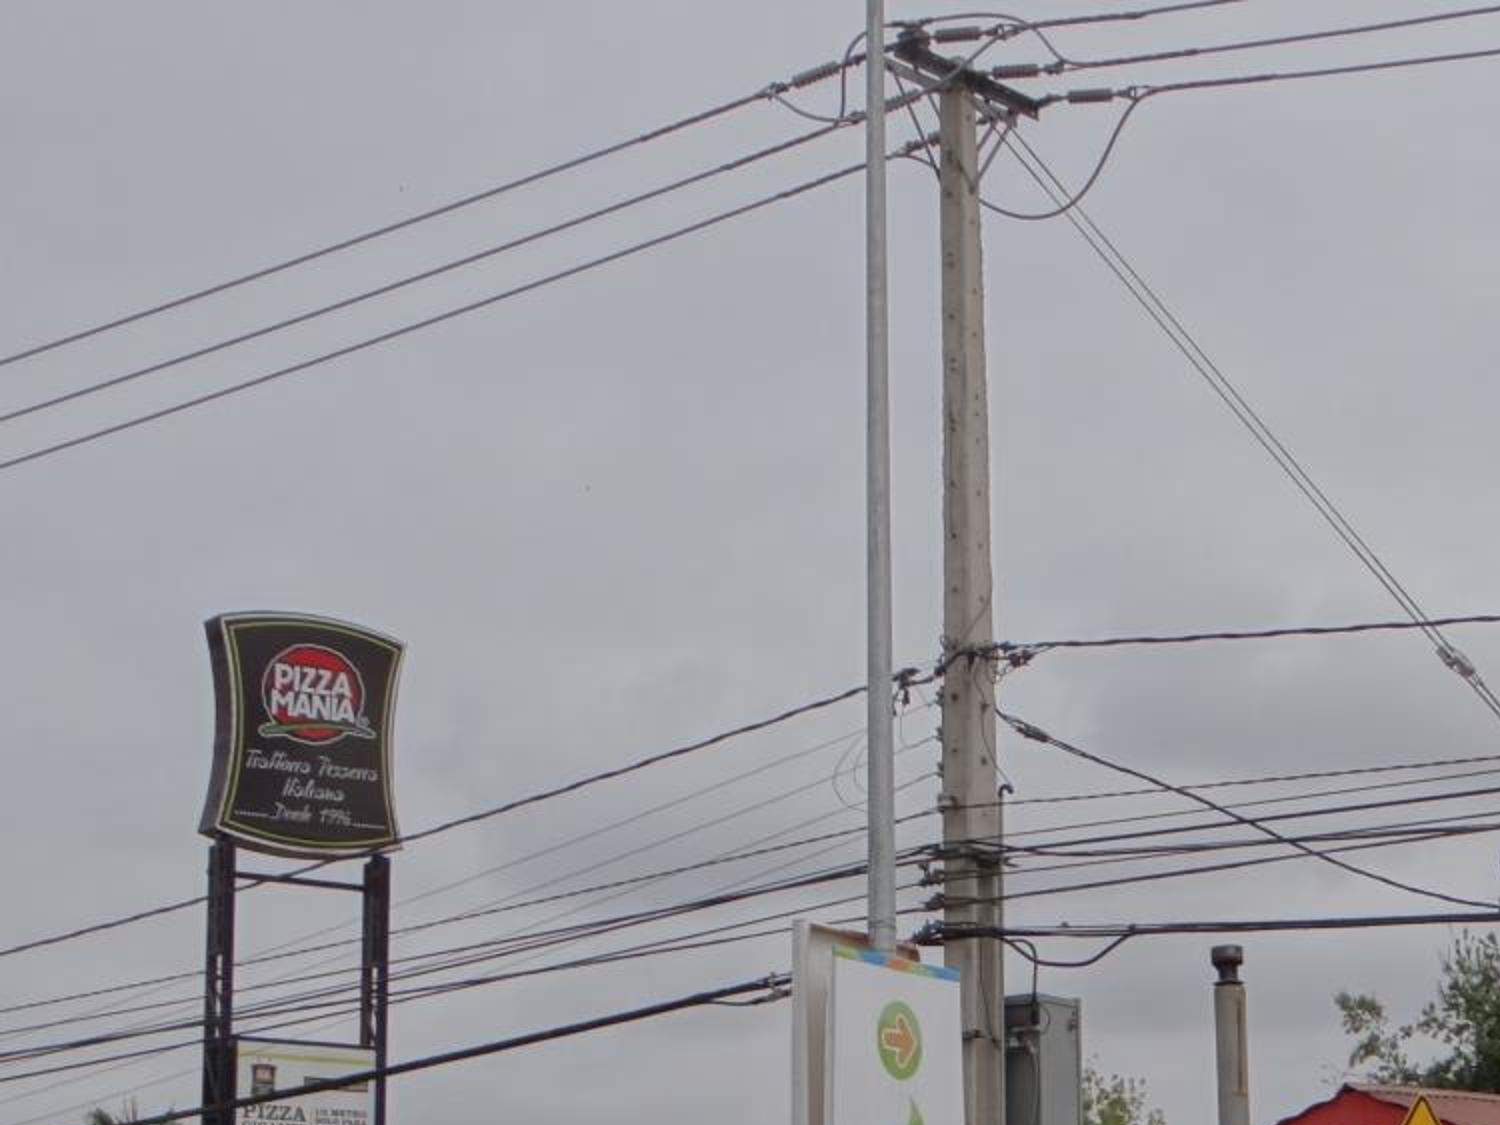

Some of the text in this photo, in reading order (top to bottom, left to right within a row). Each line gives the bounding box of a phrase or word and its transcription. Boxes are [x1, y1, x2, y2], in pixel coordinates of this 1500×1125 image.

[275, 663, 353, 698] PIZZA
[271, 688, 355, 724] MANIA
[242, 1102, 306, 1122] PIZZA
